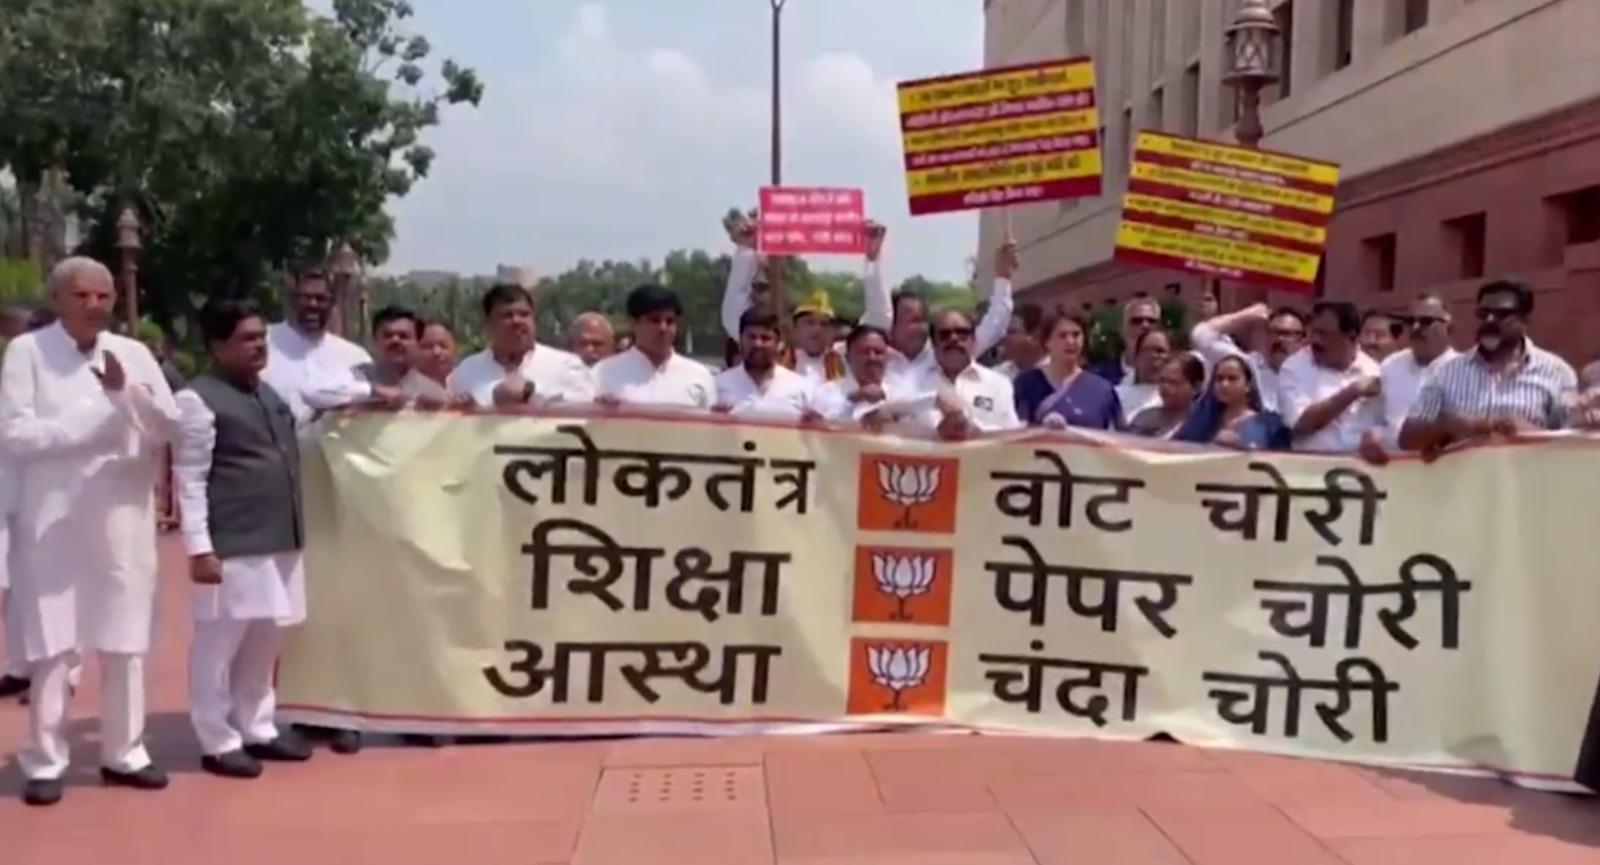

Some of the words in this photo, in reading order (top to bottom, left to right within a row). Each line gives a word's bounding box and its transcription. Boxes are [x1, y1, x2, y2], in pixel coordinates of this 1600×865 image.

[494, 426, 816, 514] लोकतंत्र
[990, 450, 1145, 532] वोट
[1195, 461, 1388, 545] चोरी
[521, 519, 790, 622] शिक्षा
[984, 536, 1192, 638] पेपर
[1253, 554, 1471, 650] चोरी
[484, 640, 782, 704] आस्था
[979, 640, 1148, 726] चंदा
[1203, 651, 1399, 743] चोरी
